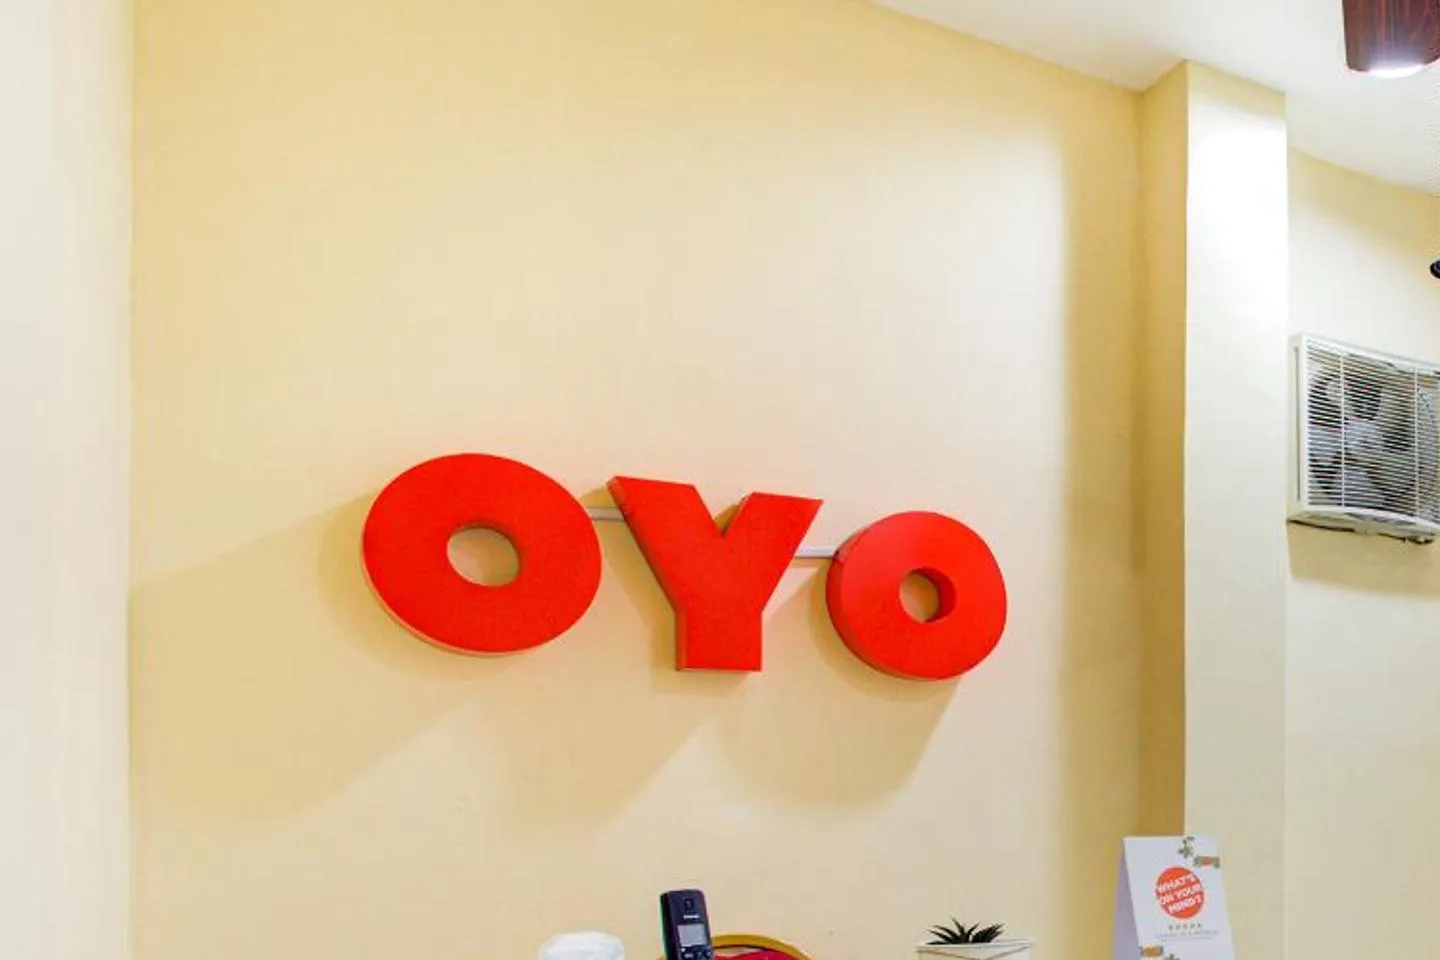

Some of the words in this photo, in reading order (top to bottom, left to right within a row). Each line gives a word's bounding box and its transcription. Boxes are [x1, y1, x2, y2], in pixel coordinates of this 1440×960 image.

[362, 453, 1007, 681] OYO
[1159, 893, 1174, 905] ON
[1177, 883, 1202, 898] YOUR
